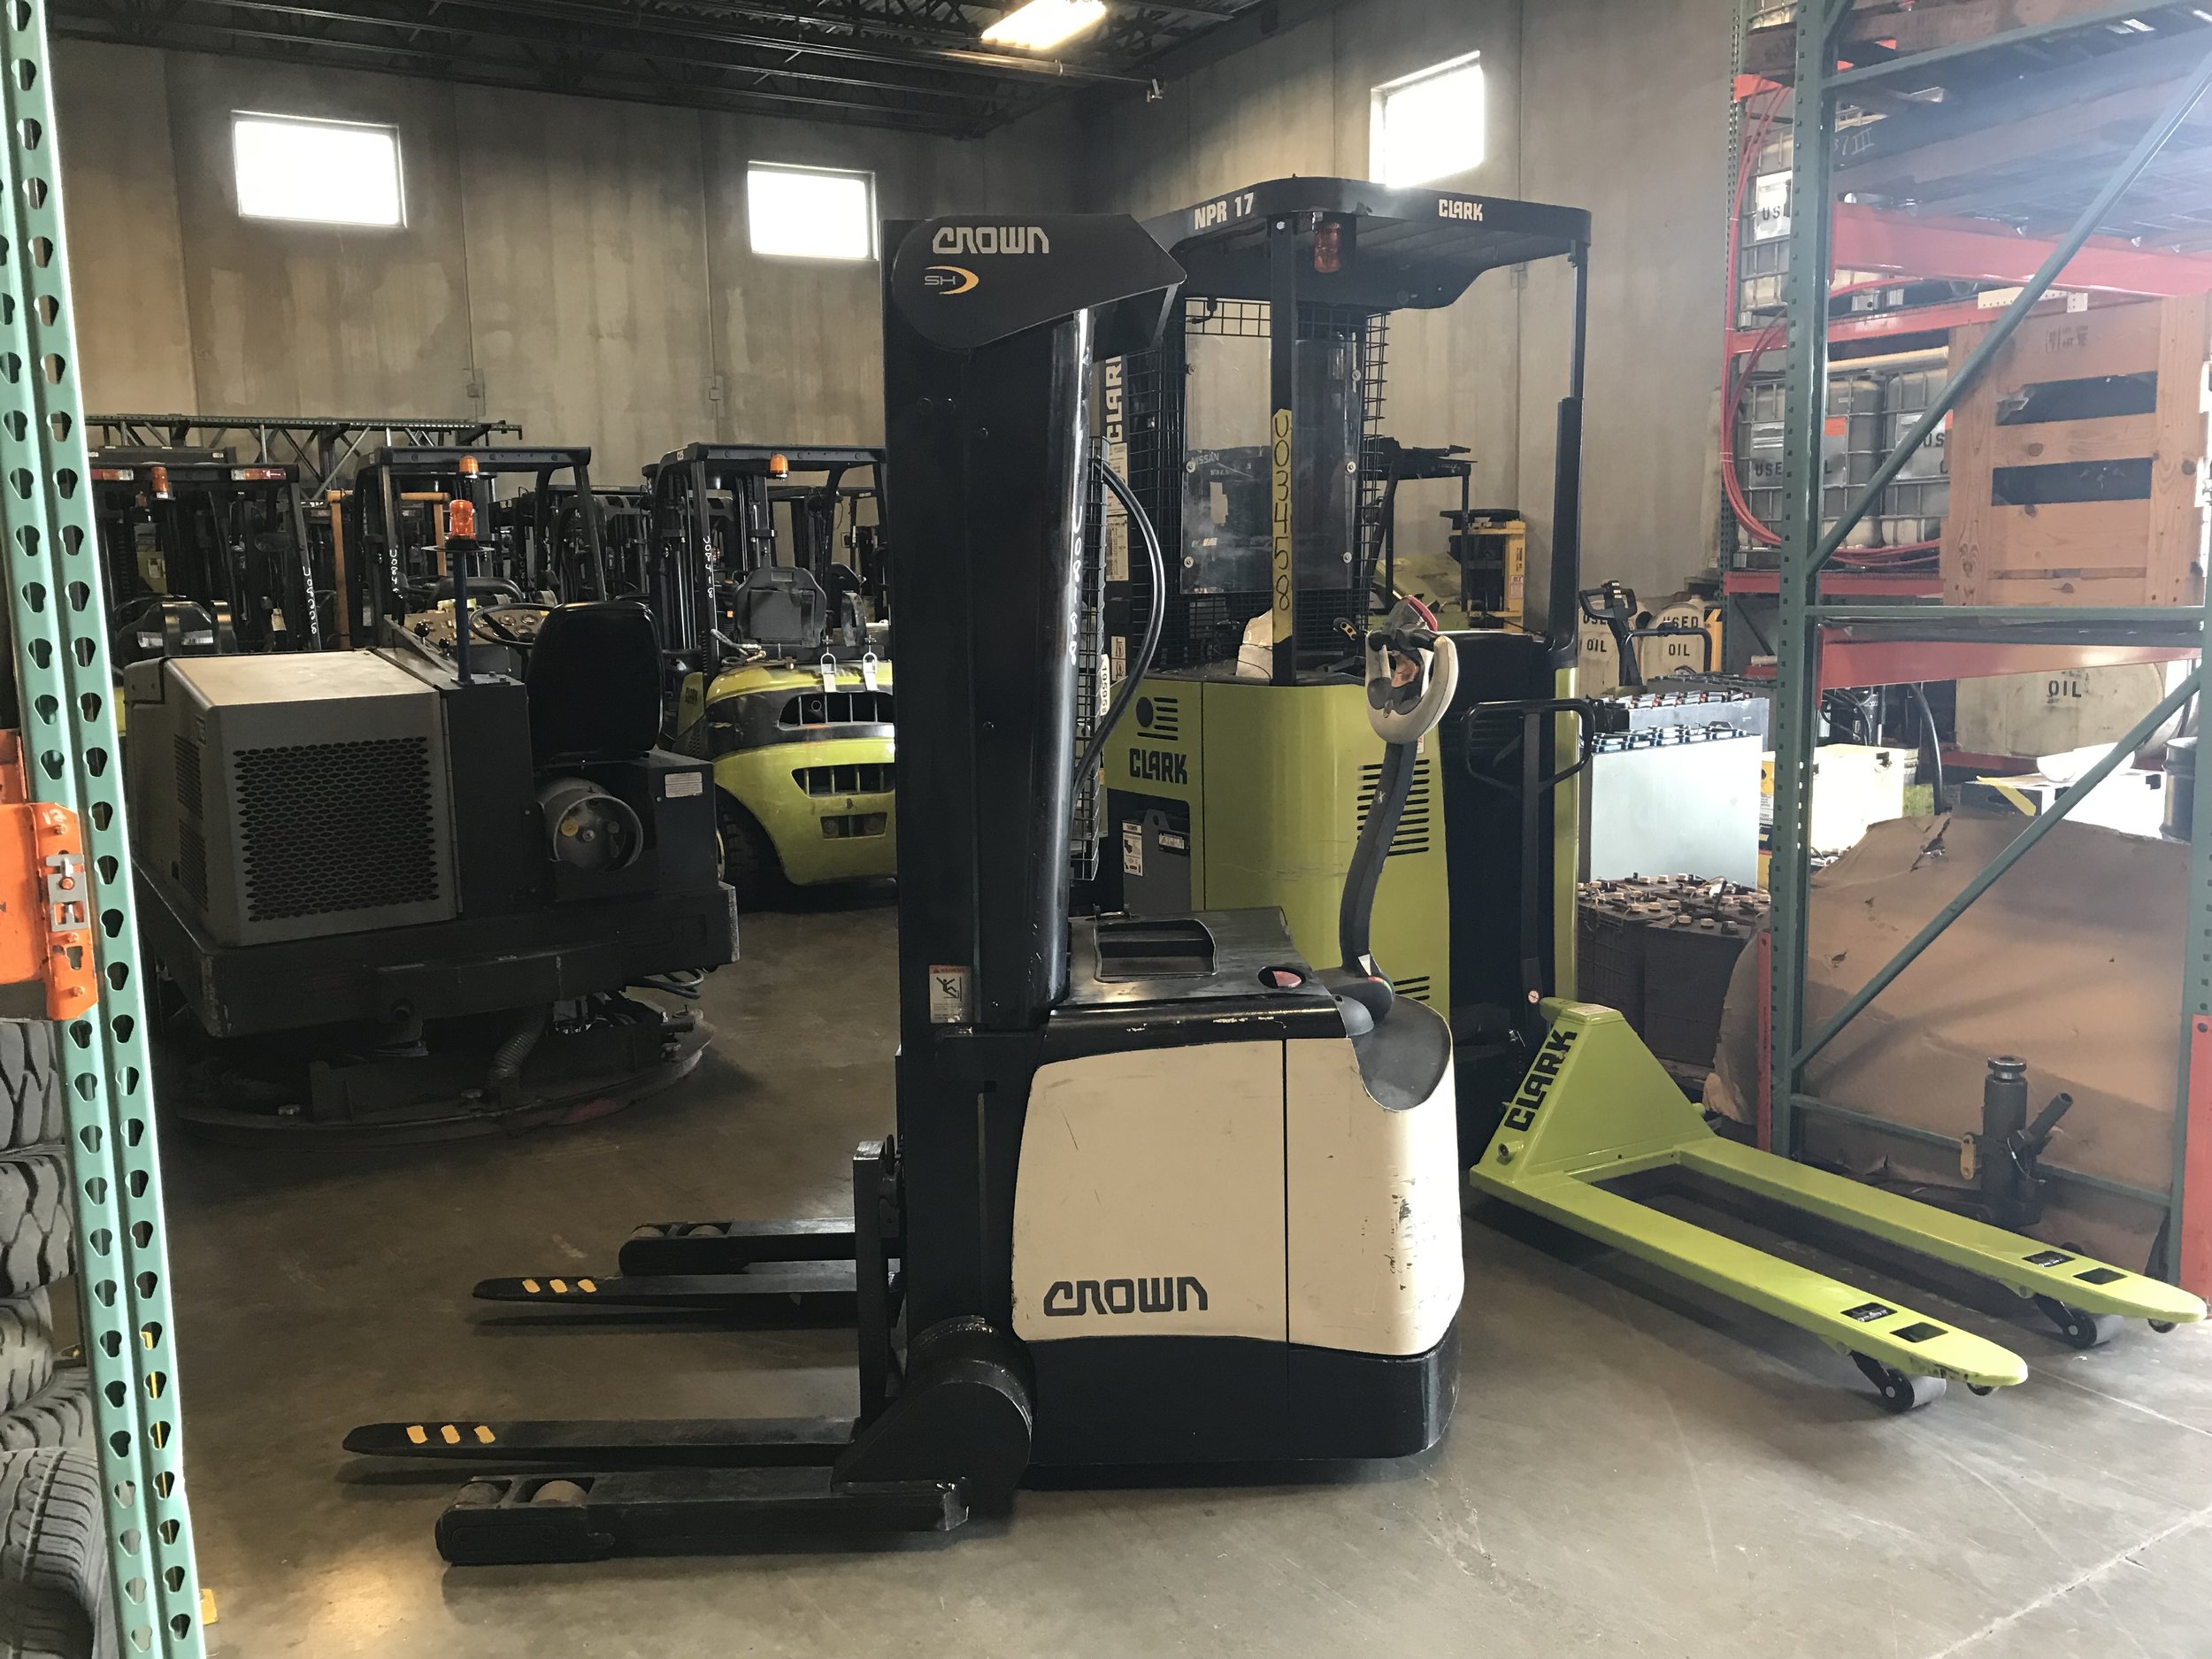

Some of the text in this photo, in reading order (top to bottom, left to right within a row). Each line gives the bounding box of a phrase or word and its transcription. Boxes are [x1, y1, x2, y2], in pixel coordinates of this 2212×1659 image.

[1194, 192, 1254, 230] NPR 17
[1439, 198, 1483, 222] CLARK
[933, 227, 1049, 254] CROWN
[925, 275, 956, 285] SH
[1755, 462, 1783, 476] USE
[1274, 415, 1290, 611] U03458
[1583, 614, 1607, 625] USE
[1586, 639, 1608, 653] OIL
[1668, 643, 1691, 657] OIL
[2048, 680, 2082, 698] OIL
[1130, 748, 1188, 785] CLARK
[1504, 1029, 1578, 1132] CLARK
[1043, 1276, 1208, 1317] CROWN
